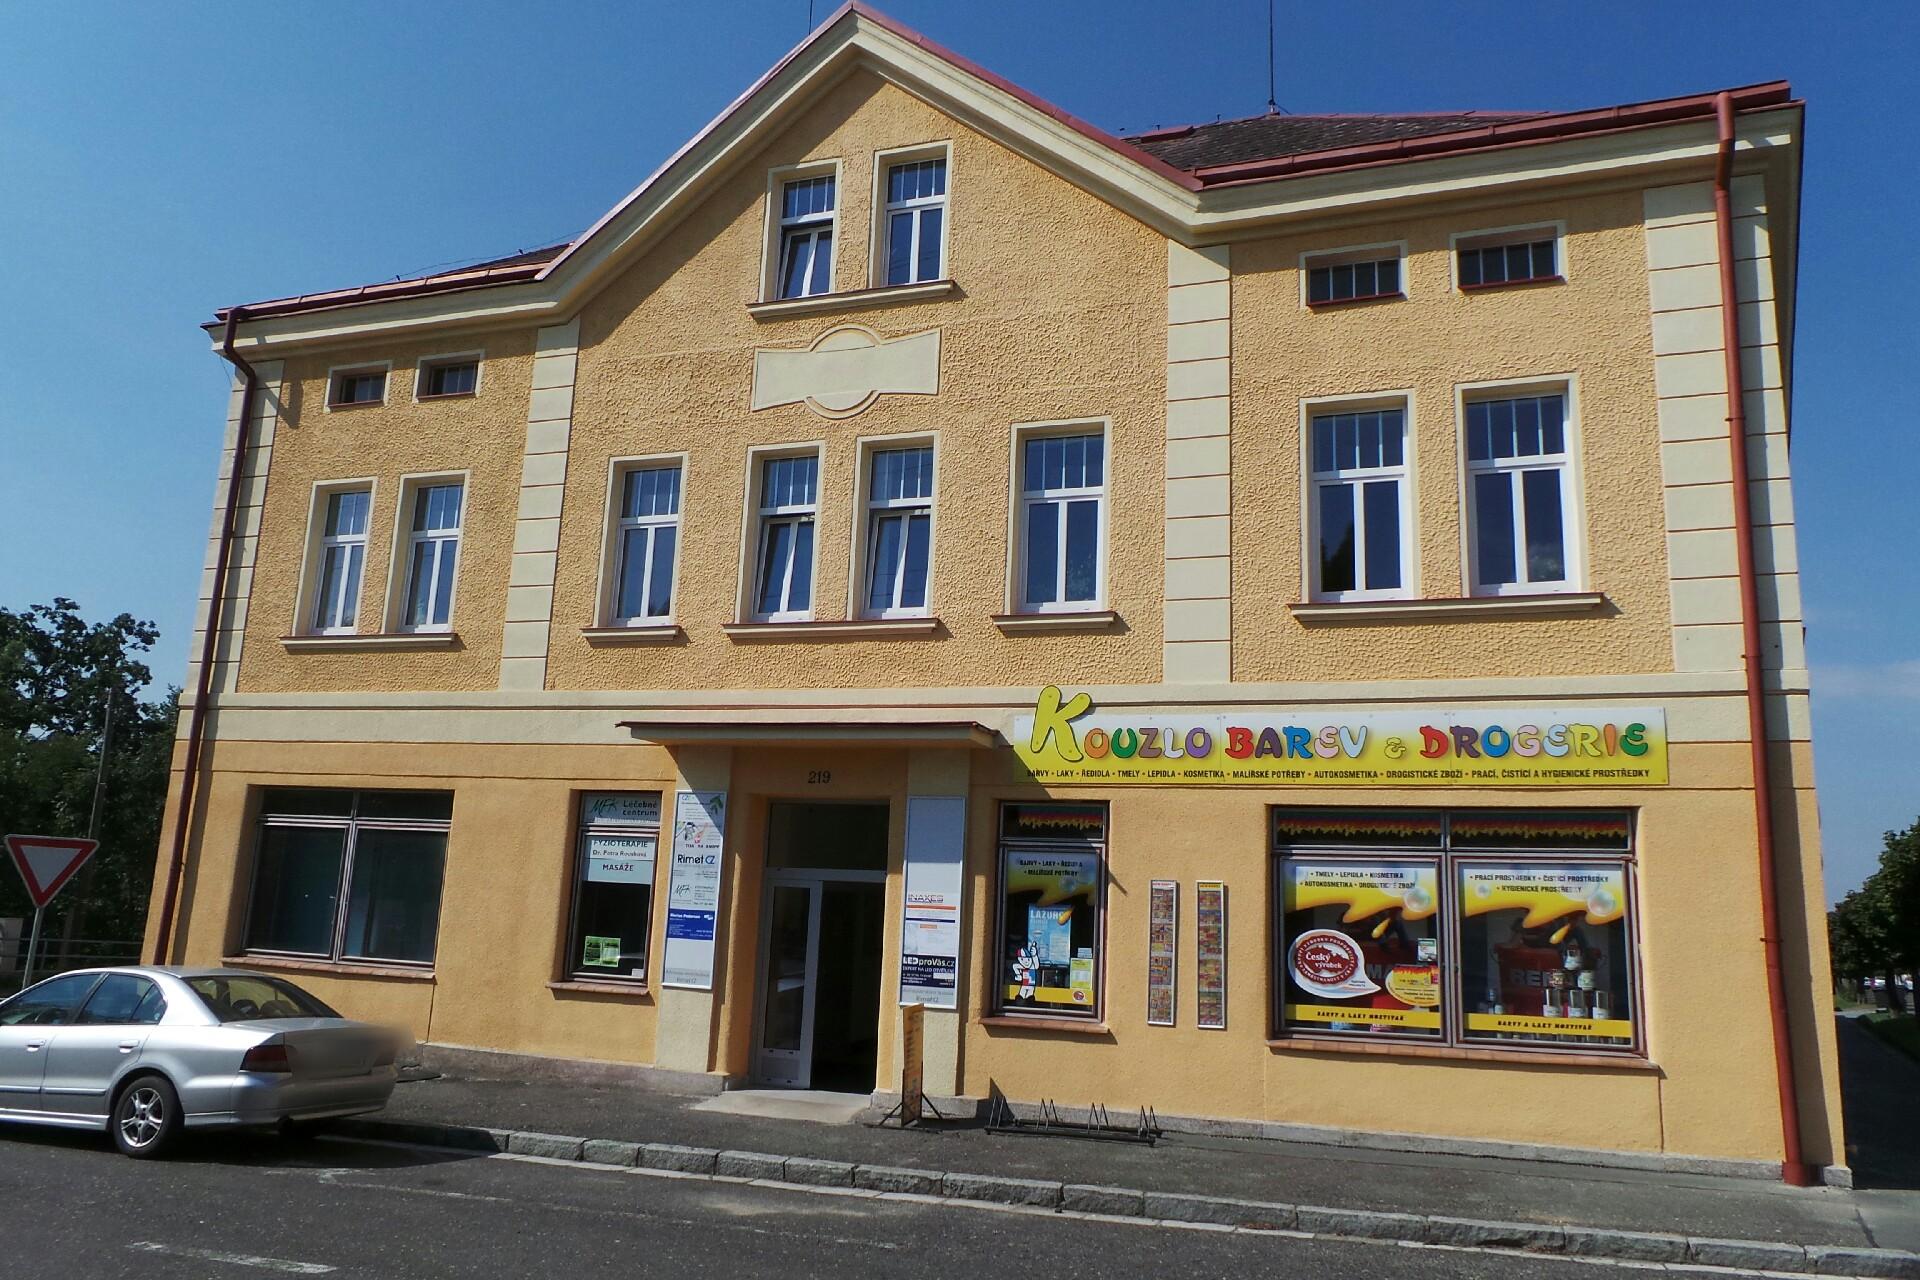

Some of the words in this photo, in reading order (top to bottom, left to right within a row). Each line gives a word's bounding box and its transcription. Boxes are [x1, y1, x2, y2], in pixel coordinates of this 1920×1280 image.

[1030, 685, 1212, 763] KOUZLO
[1225, 725, 1368, 760] BAREV
[1383, 736, 1406, 760] &
[1418, 723, 1649, 759] DROGERIE
[807, 769, 832, 785] 219
[1027, 769, 1050, 777] BARVY
[1056, 769, 1075, 778] LAKY
[1081, 767, 1110, 778] ŘEDIDLA
[1117, 769, 1140, 778] TMELY
[1147, 769, 1176, 778] LEPIDLA
[1183, 769, 1225, 778] KOSMETIKA
[1232, 768, 1269, 779] MALÍŘSKÉ
[1271, 768, 1306, 779] POTŘEBY
[1313, 769, 1379, 778] AUTOKOSMETIKA
[1386, 769, 1439, 779] DROGISTICKÉ
[1440, 768, 1463, 779] ZBOŽÍ
[1534, 769, 1540, 778] A
[1541, 768, 1591, 778] HYGIENICKÉ
[1592, 767, 1650, 778] PROSTŘEDKY
[622, 808, 658, 817] centrum
[593, 839, 649, 848] FYZIOTERAPIE
[677, 854, 704, 865] Rimet
[705, 855, 716, 865] CZ
[602, 862, 635, 872] MASÁŽE
[1304, 880, 1354, 888] AUTOKOSMETIKA
[1305, 951, 1331, 963] Český
[1315, 961, 1343, 969] výrobek
